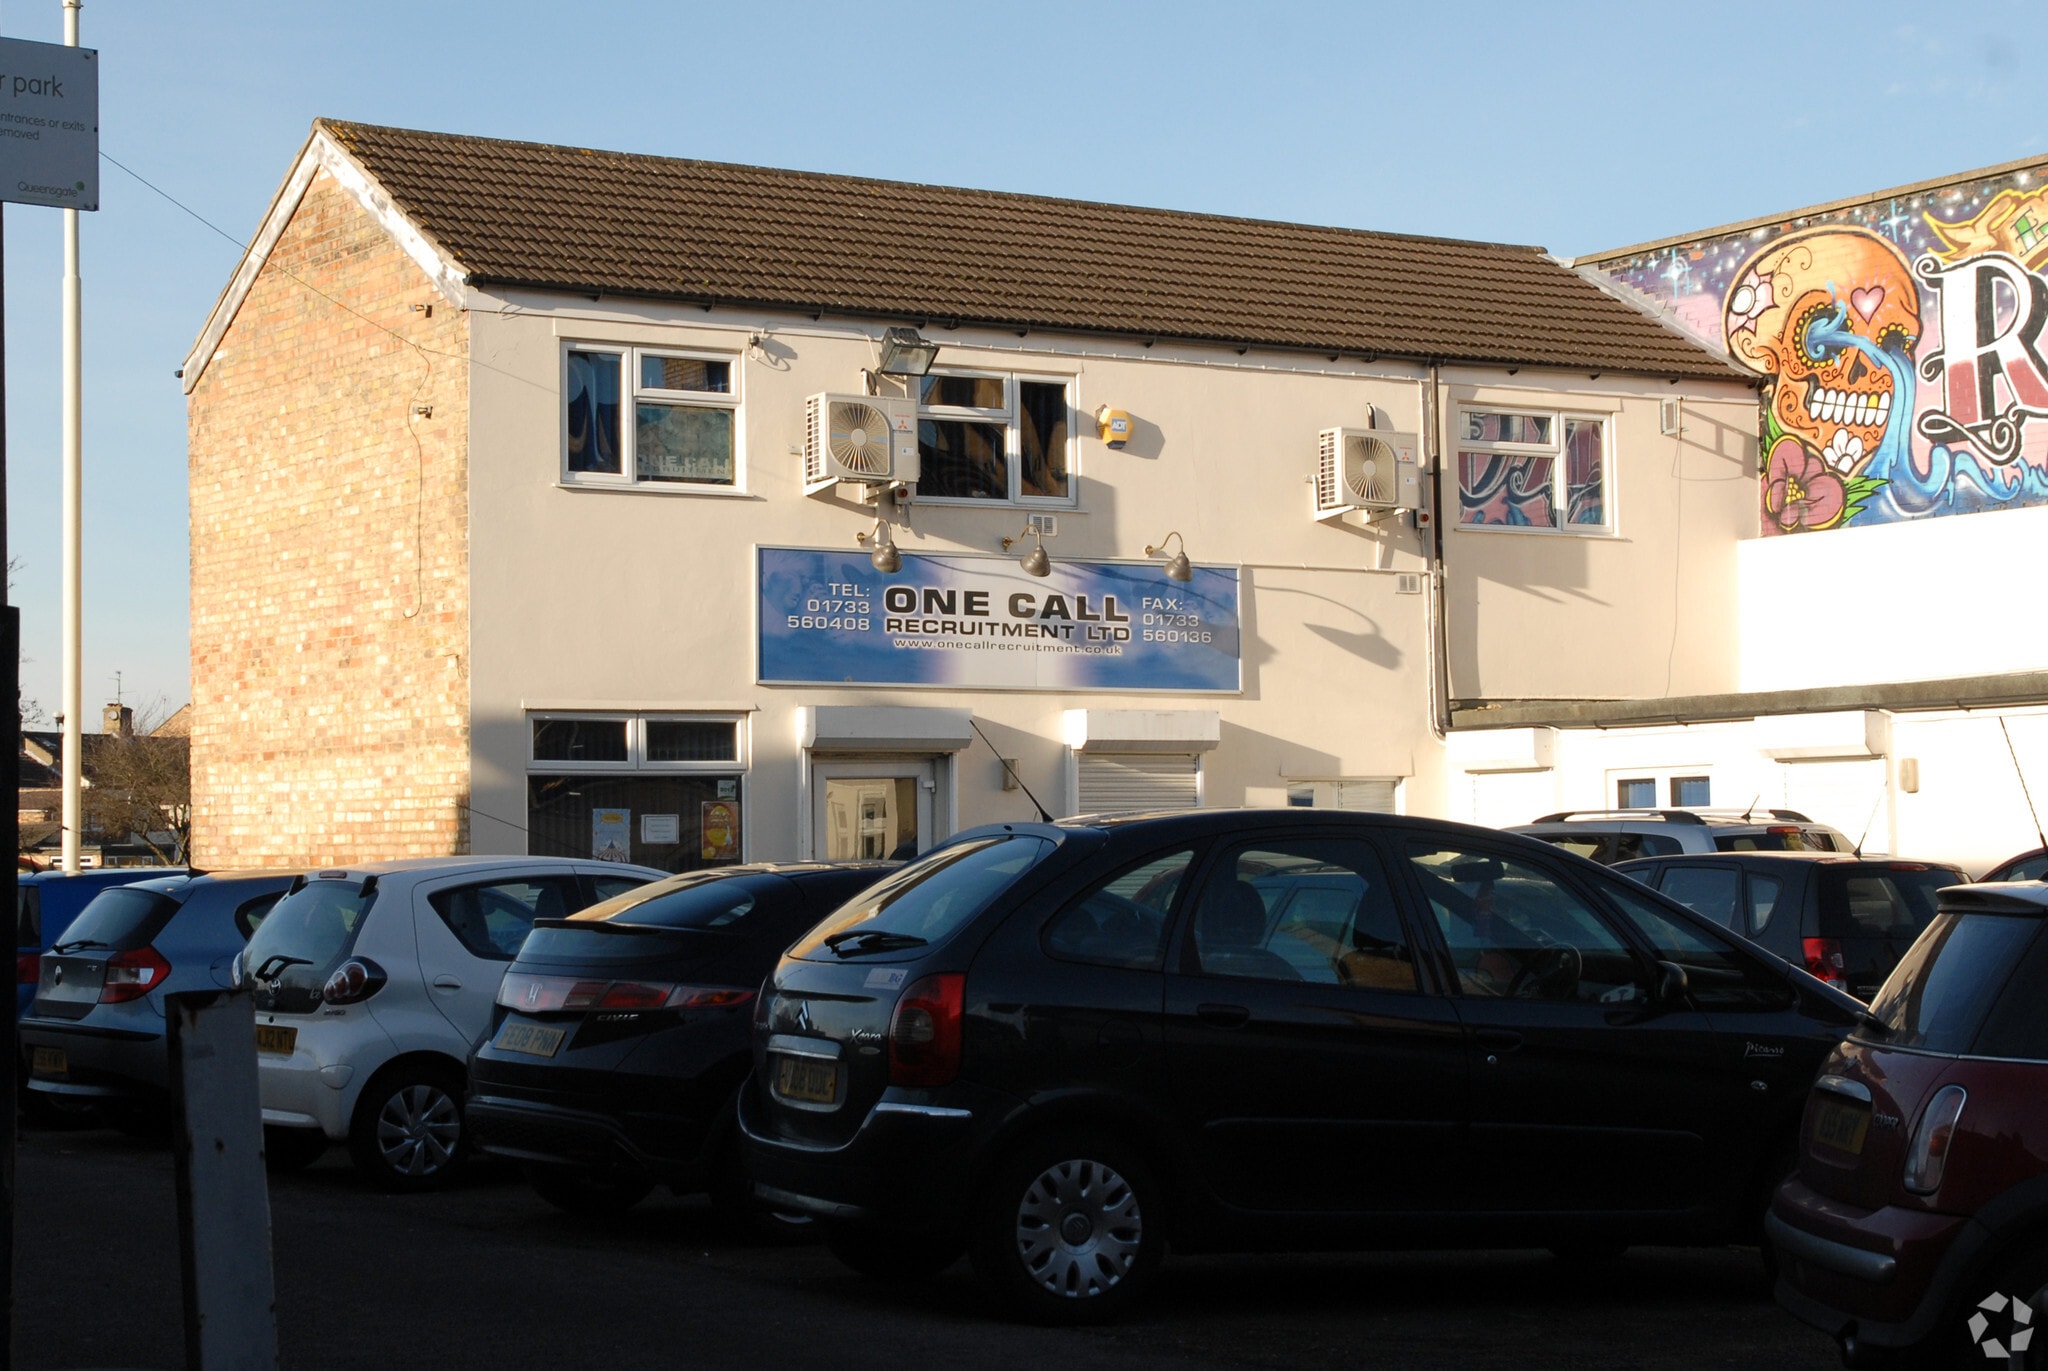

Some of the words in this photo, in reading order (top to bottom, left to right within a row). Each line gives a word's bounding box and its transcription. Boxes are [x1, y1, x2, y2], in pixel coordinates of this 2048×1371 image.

[13, 75, 64, 98] park
[0, 112, 47, 128] ntrances
[48, 119, 59, 129] or
[62, 120, 86, 132] exits
[17, 181, 78, 198] Queensgate
[829, 583, 870, 597] TEL:
[807, 599, 870, 614] 01733
[885, 587, 990, 617] ONE
[1008, 593, 1129, 622] CALL
[1142, 598, 1183, 611] FAX:
[787, 616, 870, 631] 560408
[1142, 613, 1199, 627] 01733
[887, 618, 1075, 639] RECRUITMENT
[1088, 626, 1130, 641] LTD
[1142, 630, 1211, 643] 560136
[894, 639, 1121, 654] www.onecallrecruitment.co.uk
